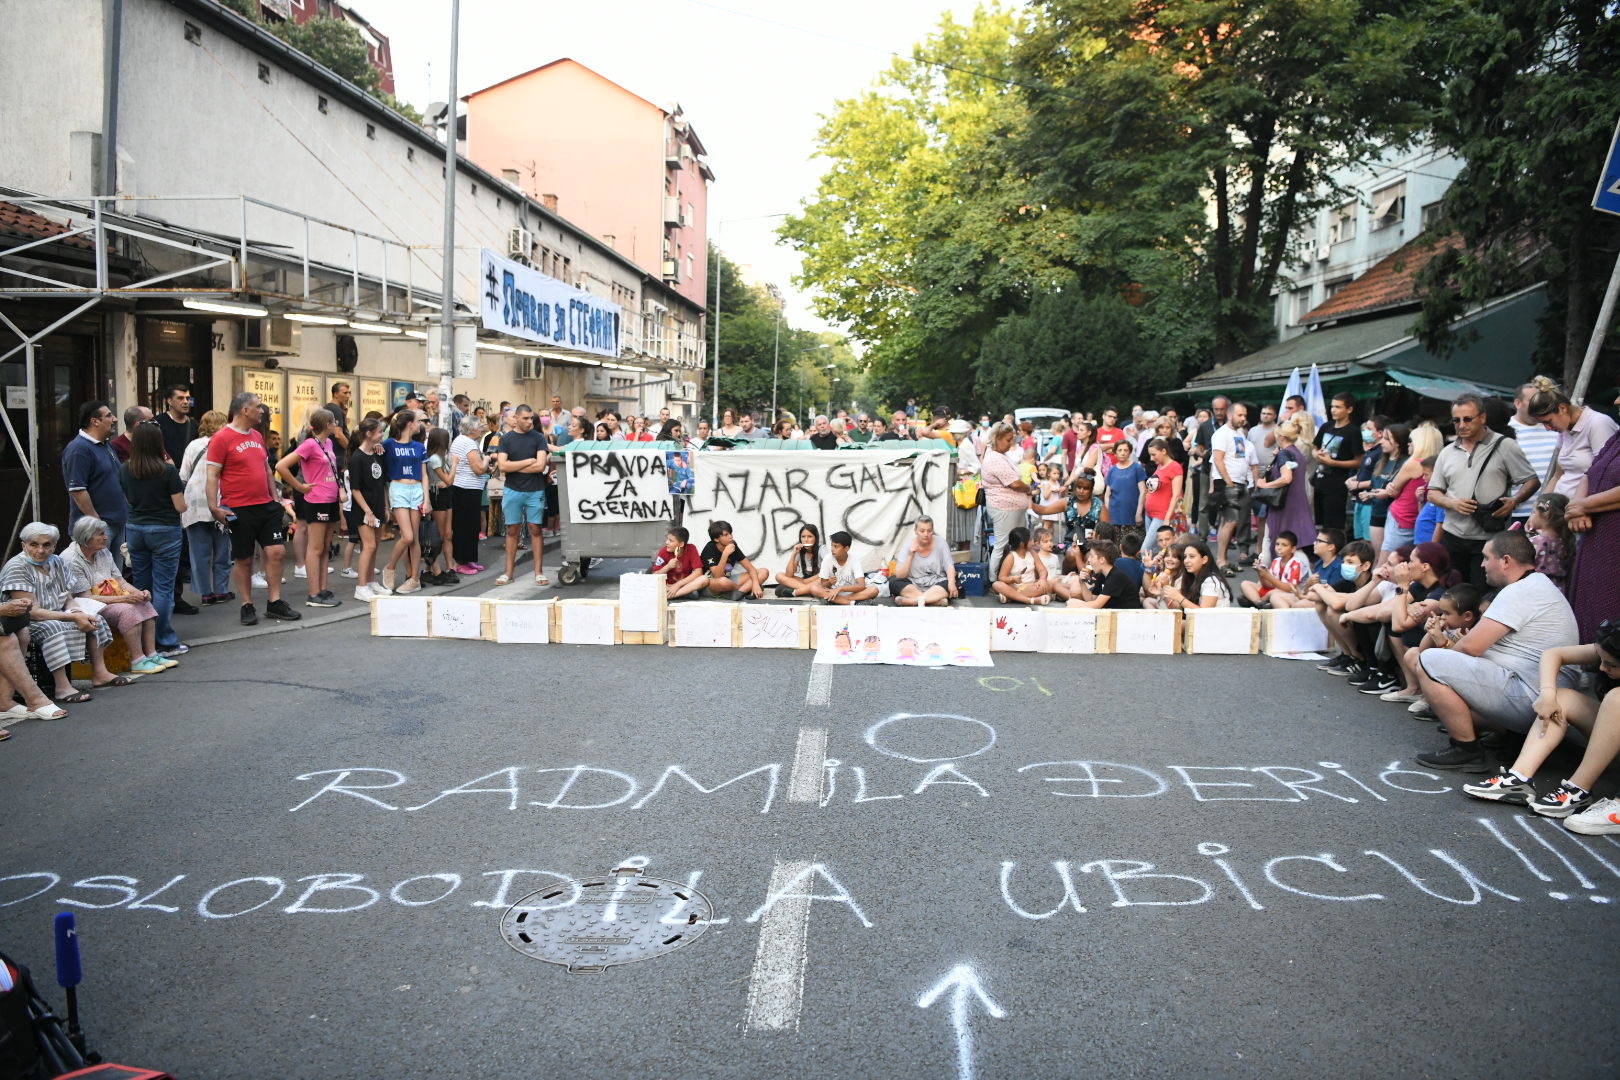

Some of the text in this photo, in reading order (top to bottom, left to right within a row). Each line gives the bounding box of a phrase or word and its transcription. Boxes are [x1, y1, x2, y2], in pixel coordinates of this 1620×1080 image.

[254, 380, 274, 391] БЕЛИ
[296, 385, 315, 395] ХЛЕБ
[571, 451, 666, 479] PRAVDA
[604, 479, 638, 500] ZA
[578, 499, 673, 520] STEFANA
